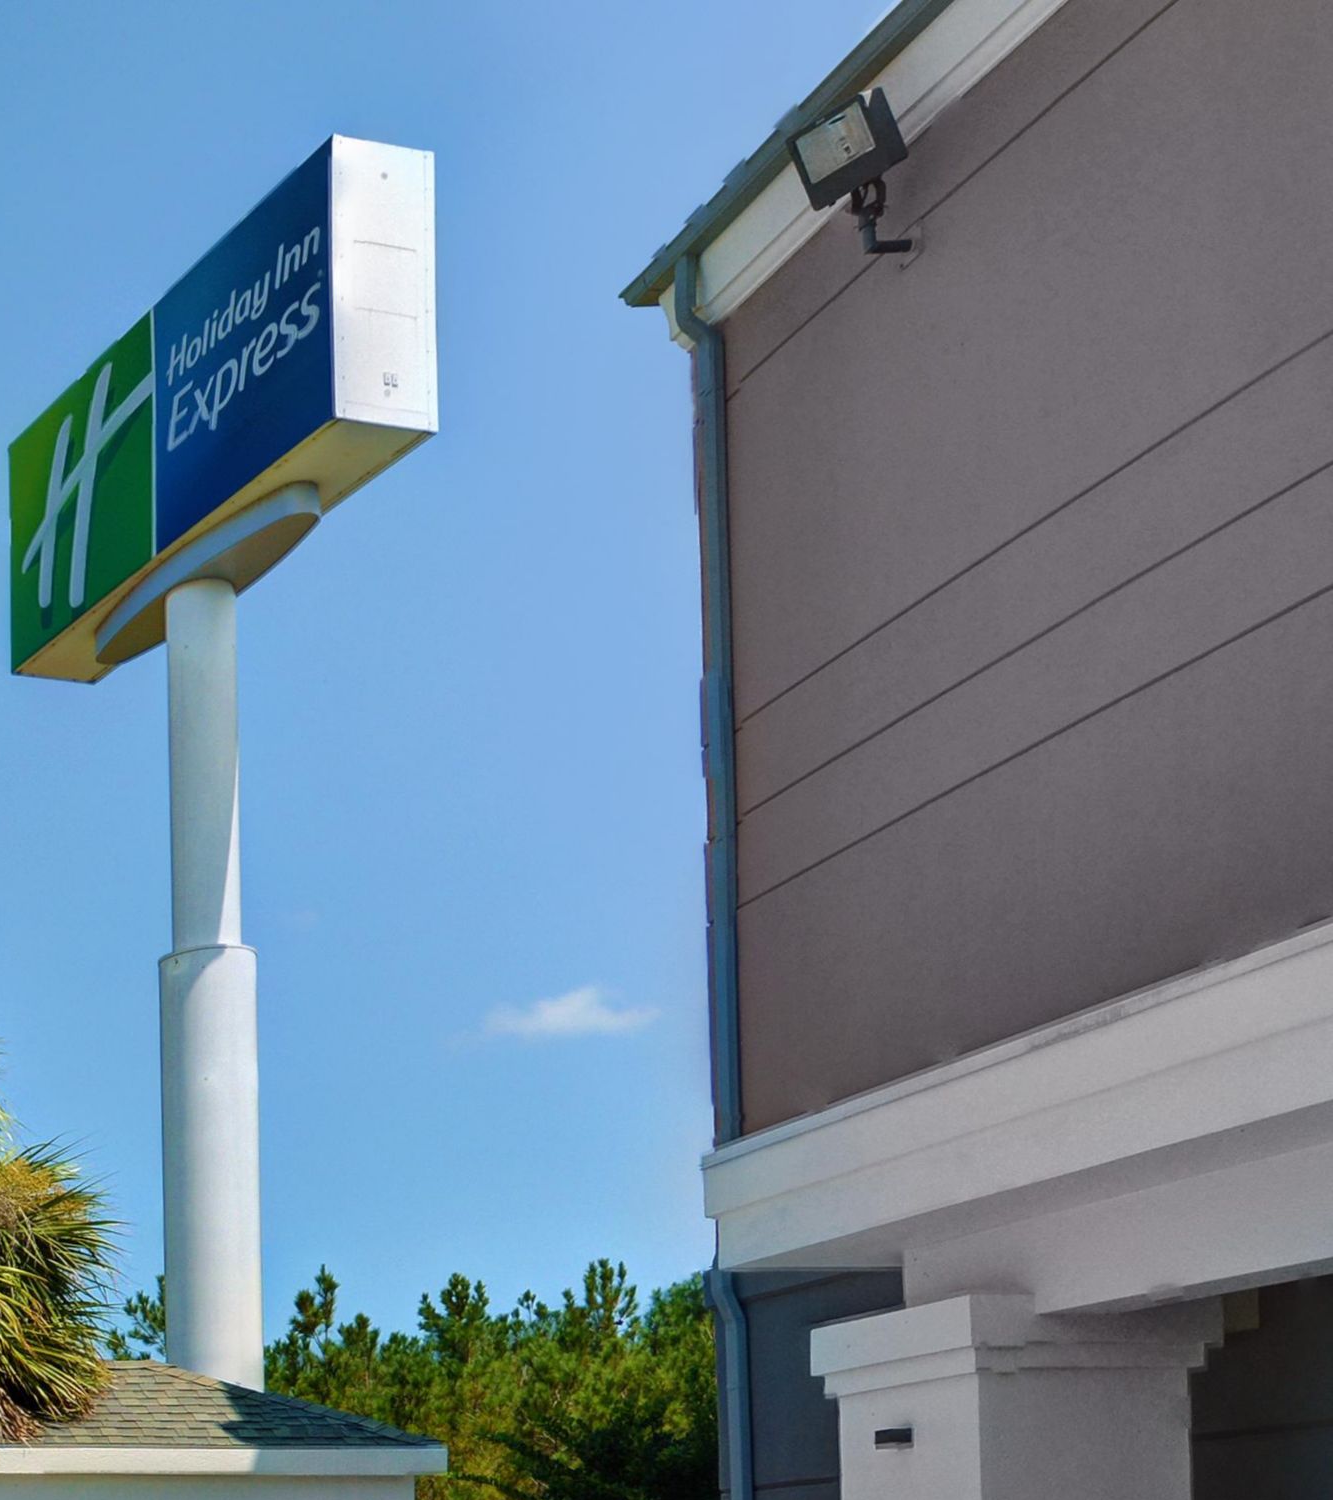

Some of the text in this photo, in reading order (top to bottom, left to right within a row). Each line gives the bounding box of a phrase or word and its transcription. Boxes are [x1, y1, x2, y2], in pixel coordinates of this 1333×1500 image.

[166, 225, 321, 386] Holiday Inn
[167, 281, 321, 452] Express
